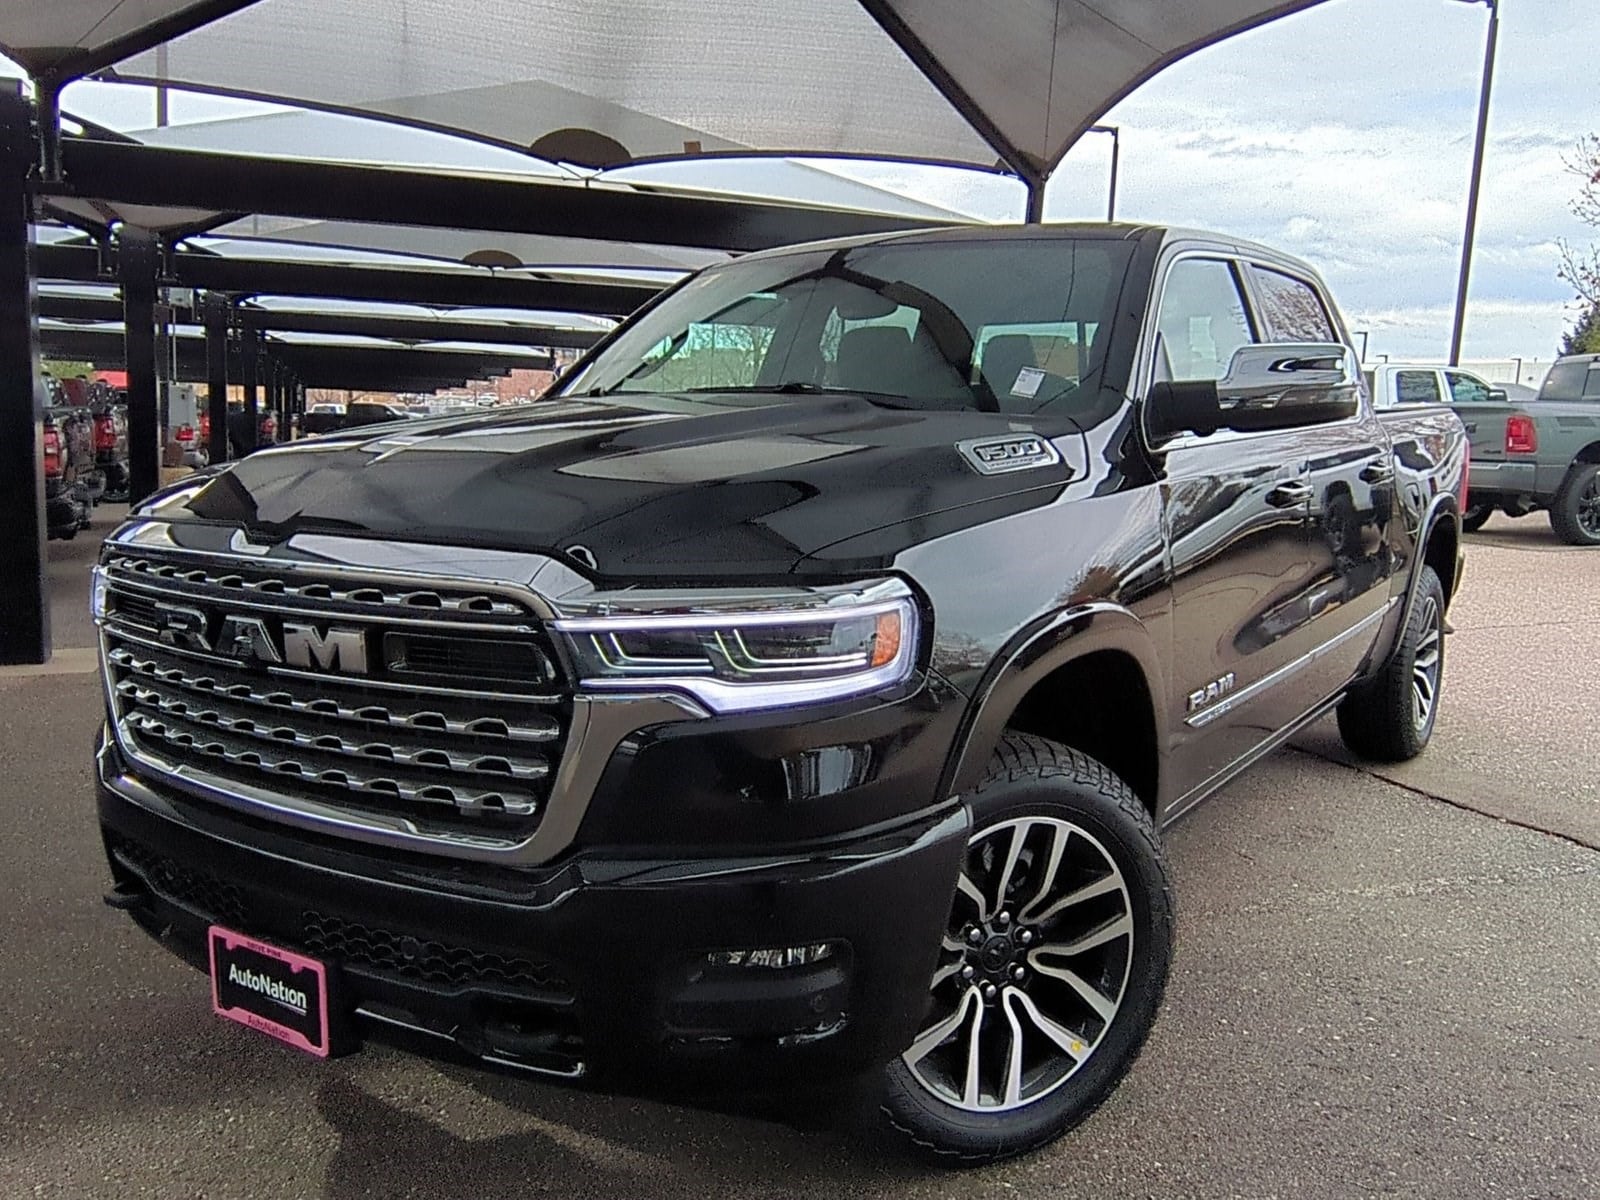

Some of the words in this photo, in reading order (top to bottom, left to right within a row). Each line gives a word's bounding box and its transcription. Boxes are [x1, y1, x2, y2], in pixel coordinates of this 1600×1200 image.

[975, 441, 1041, 461] 1500
[154, 602, 368, 674] RAM
[1188, 672, 1235, 711] RAM
[229, 963, 308, 1009] AutoNation
